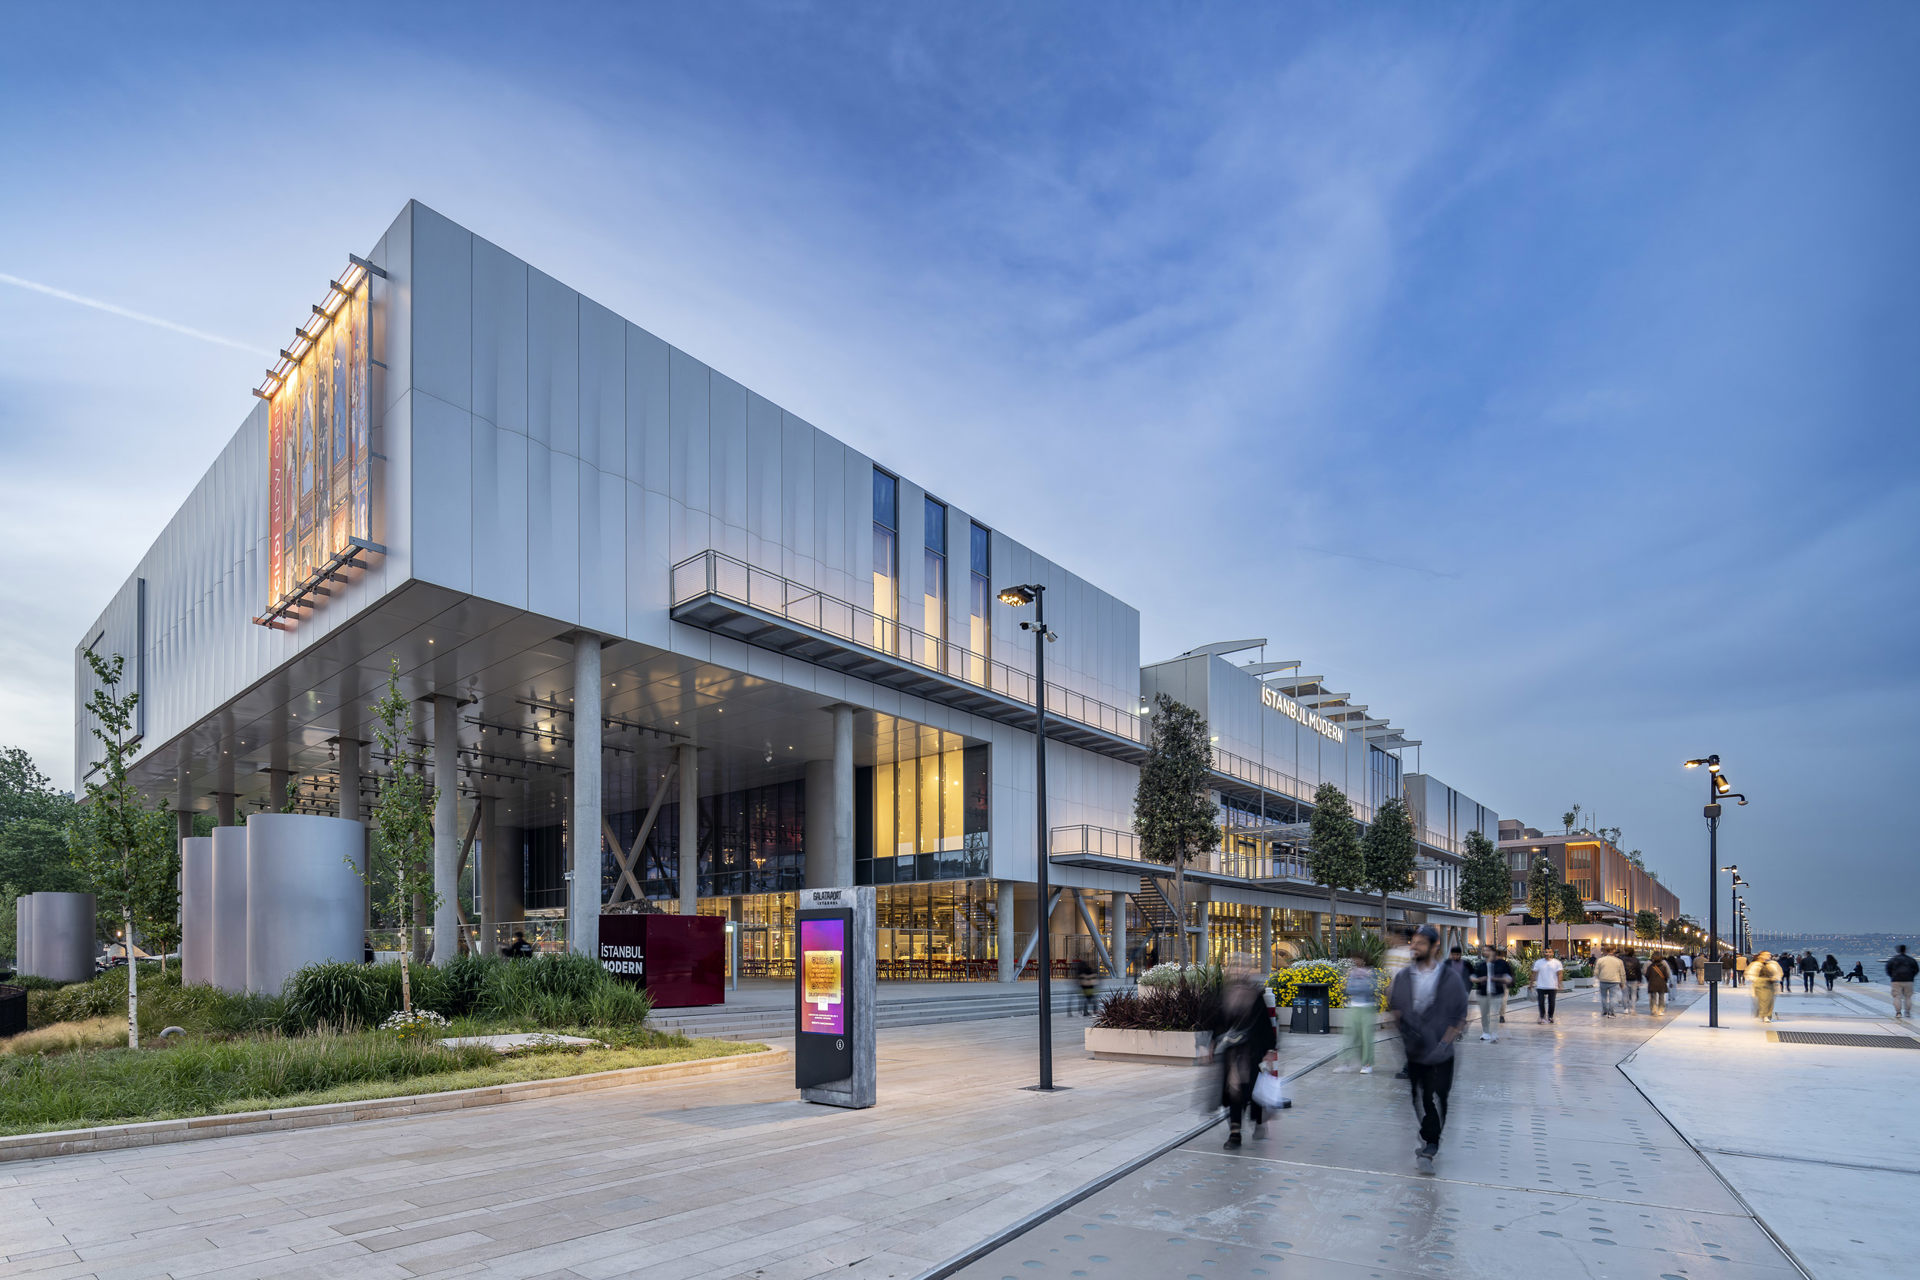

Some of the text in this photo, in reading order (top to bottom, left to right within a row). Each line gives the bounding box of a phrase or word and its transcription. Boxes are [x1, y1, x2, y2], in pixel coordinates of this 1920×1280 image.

[1308, 711, 1343, 743] MODERN
[813, 890, 842, 901] GALATAPORT
[601, 943, 644, 959] İSTANBUL
[601, 960, 643, 974] MODERN
